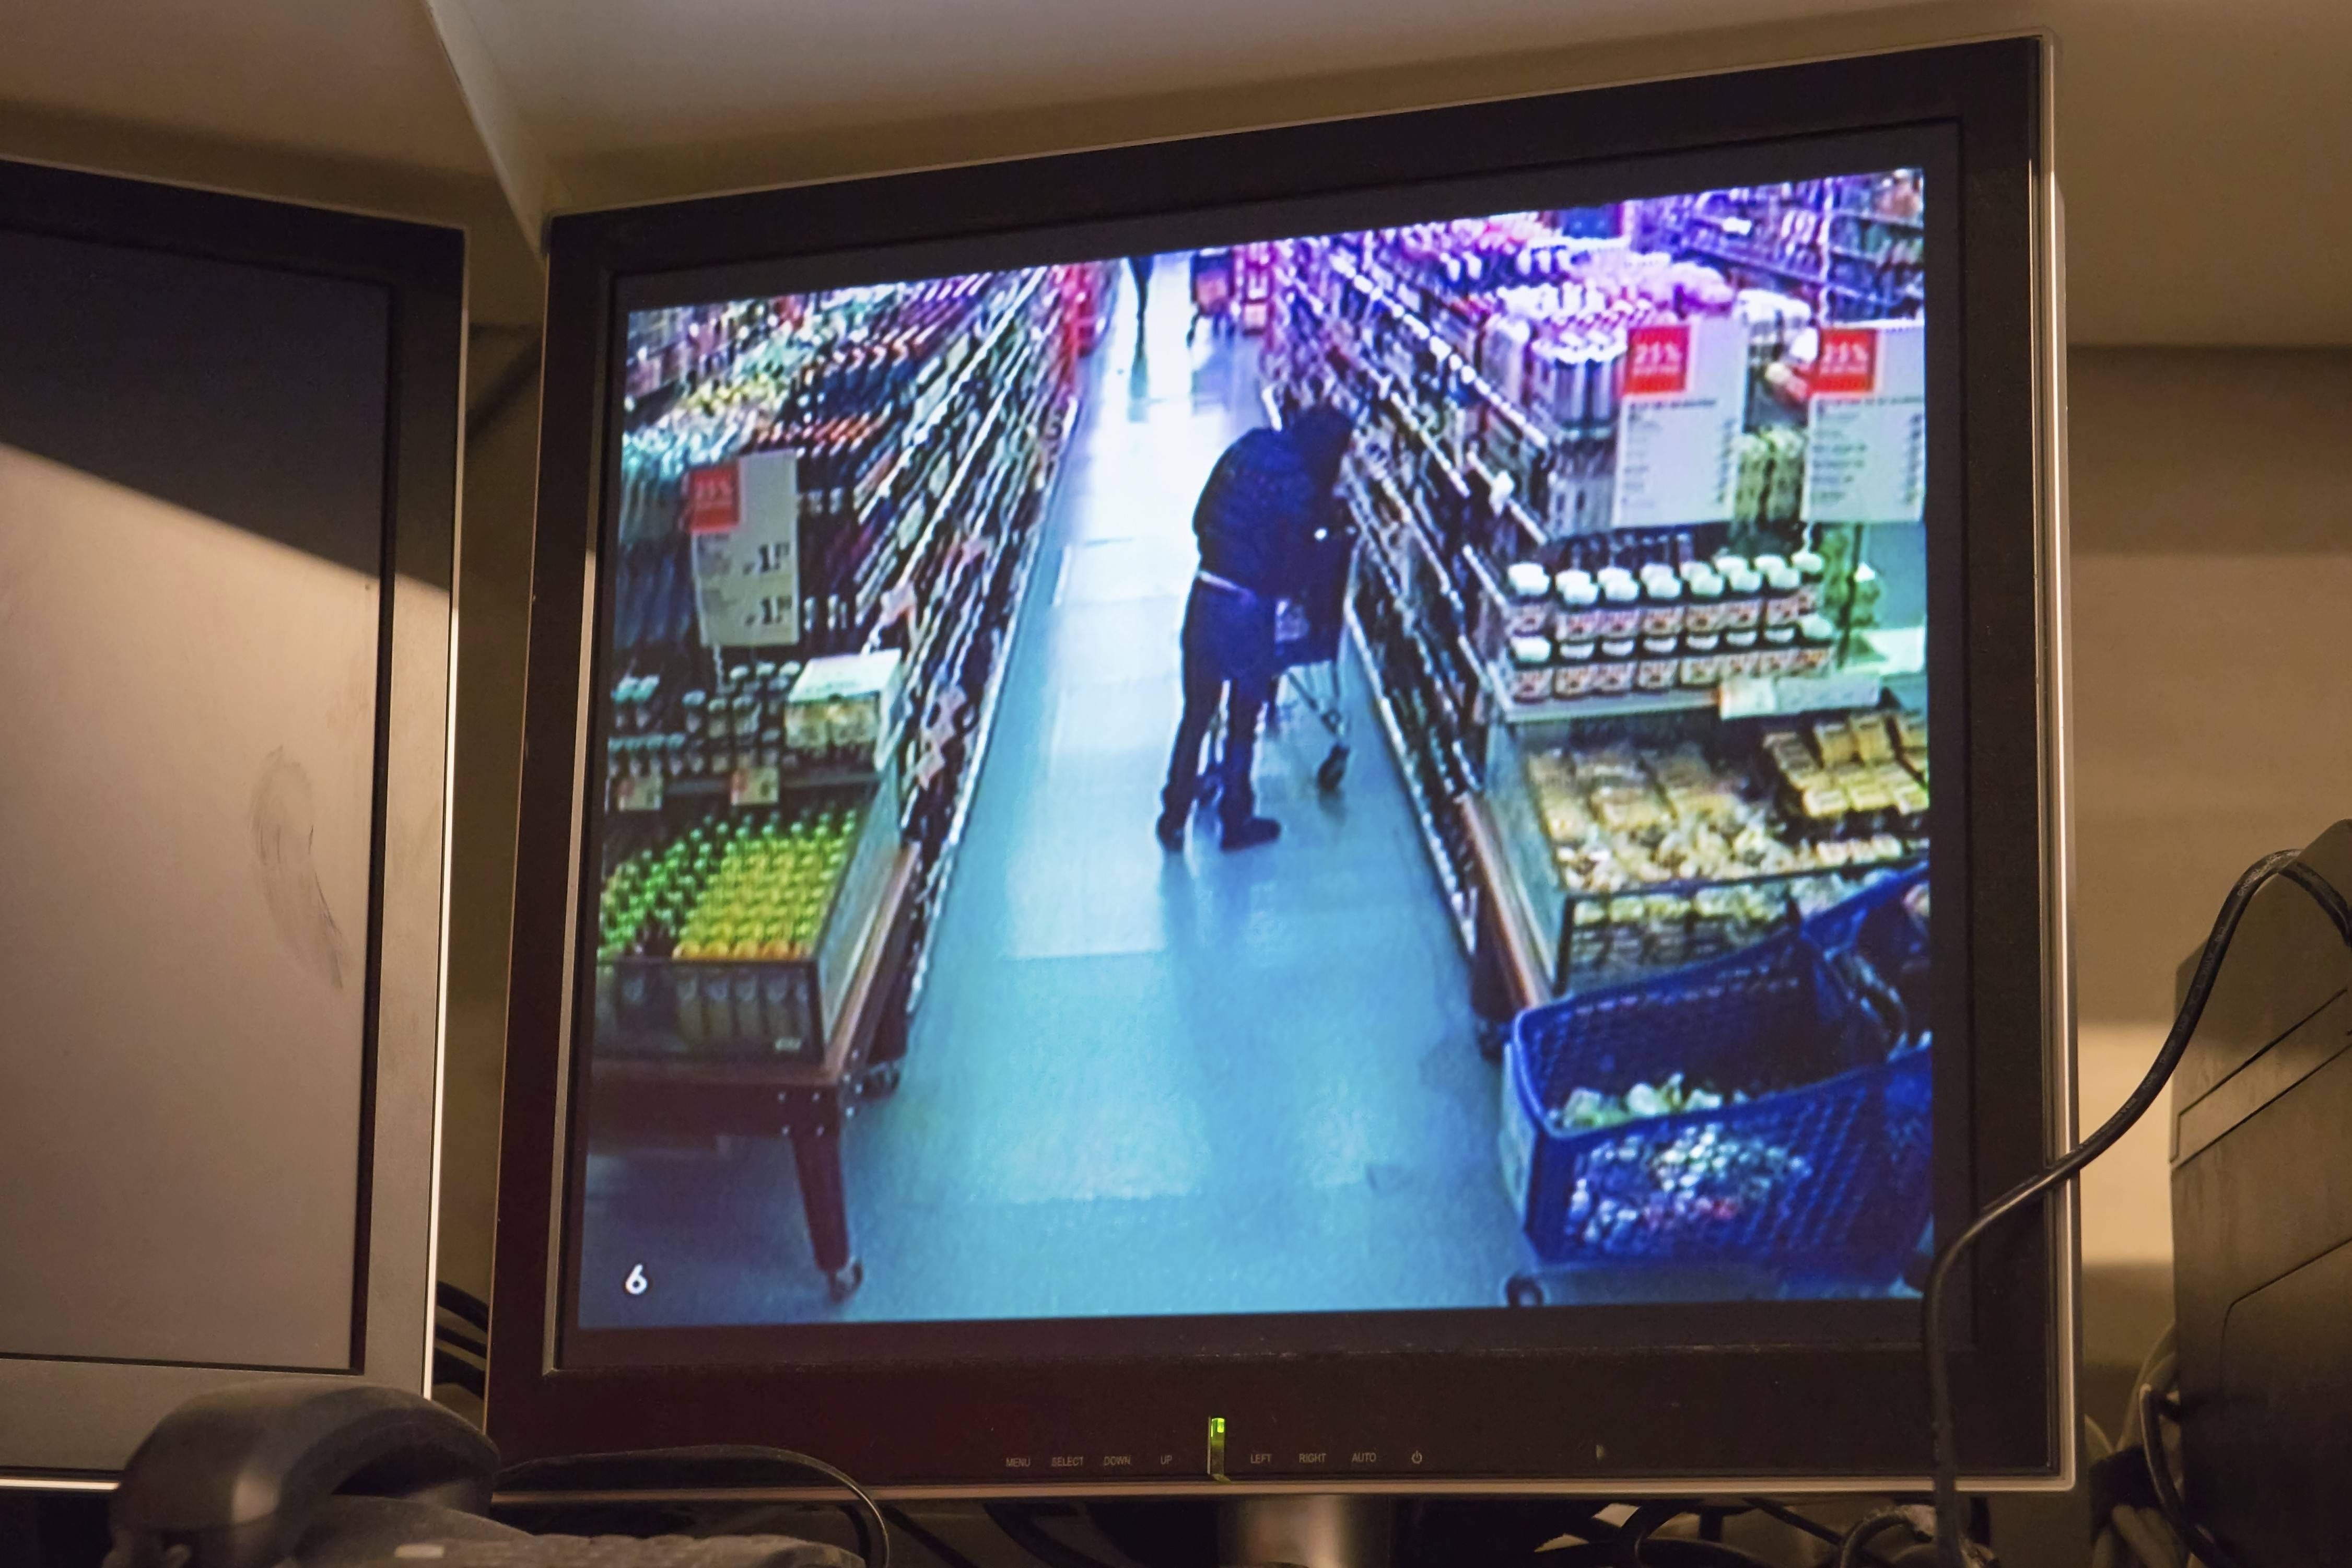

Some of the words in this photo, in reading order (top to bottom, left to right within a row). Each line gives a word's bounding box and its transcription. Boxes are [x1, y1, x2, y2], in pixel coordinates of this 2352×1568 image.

[625, 1262, 648, 1295] 6
[1005, 1457, 1031, 1467] MENU
[1051, 1456, 1084, 1467] SELECT
[1104, 1455, 1131, 1466] DOWN
[1160, 1455, 1173, 1465] UP
[1250, 1453, 1272, 1464] LEFT
[1298, 1453, 1327, 1463] RIGHT
[1351, 1452, 1377, 1462] AUTO
